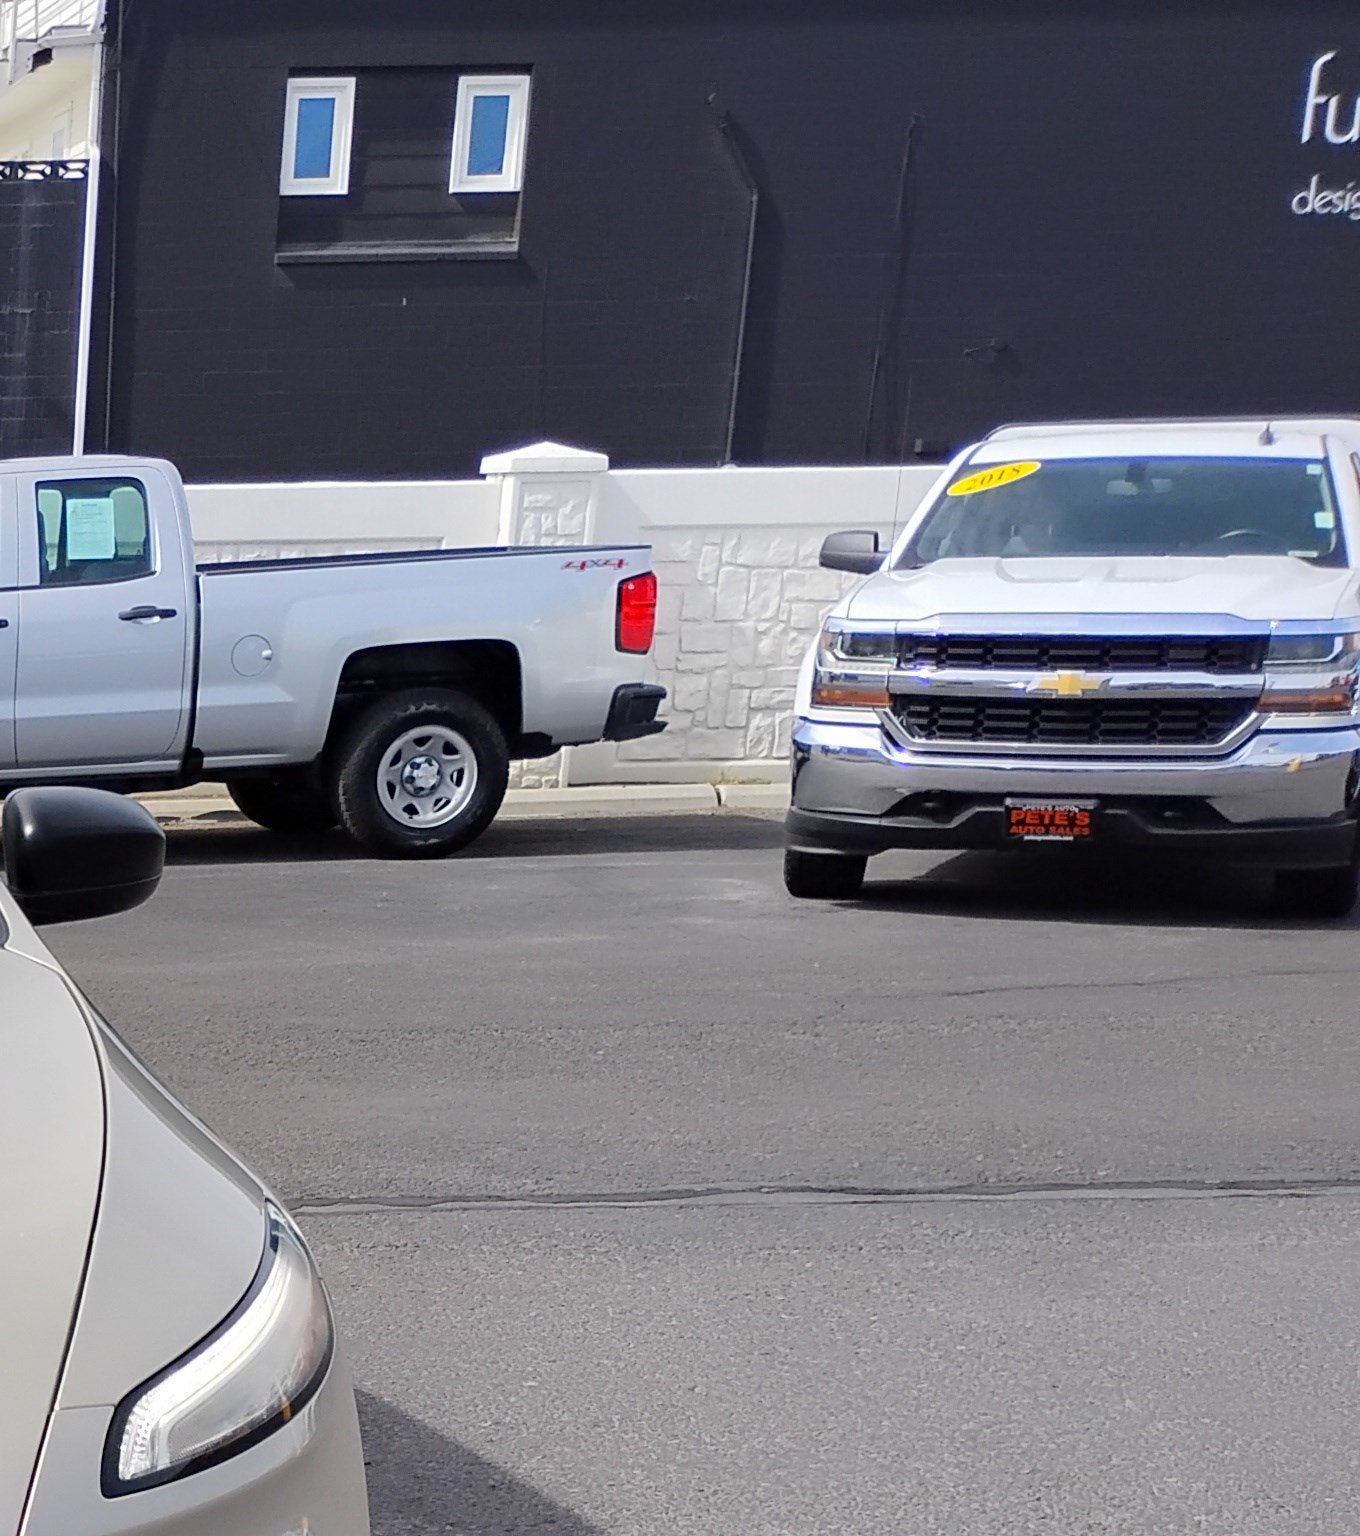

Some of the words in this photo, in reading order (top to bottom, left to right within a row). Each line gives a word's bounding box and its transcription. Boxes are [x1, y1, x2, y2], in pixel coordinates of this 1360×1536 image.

[1010, 809, 1090, 825] PETE'S
[1009, 825, 1045, 834] AUTO
[1049, 826, 1090, 835] SALES
